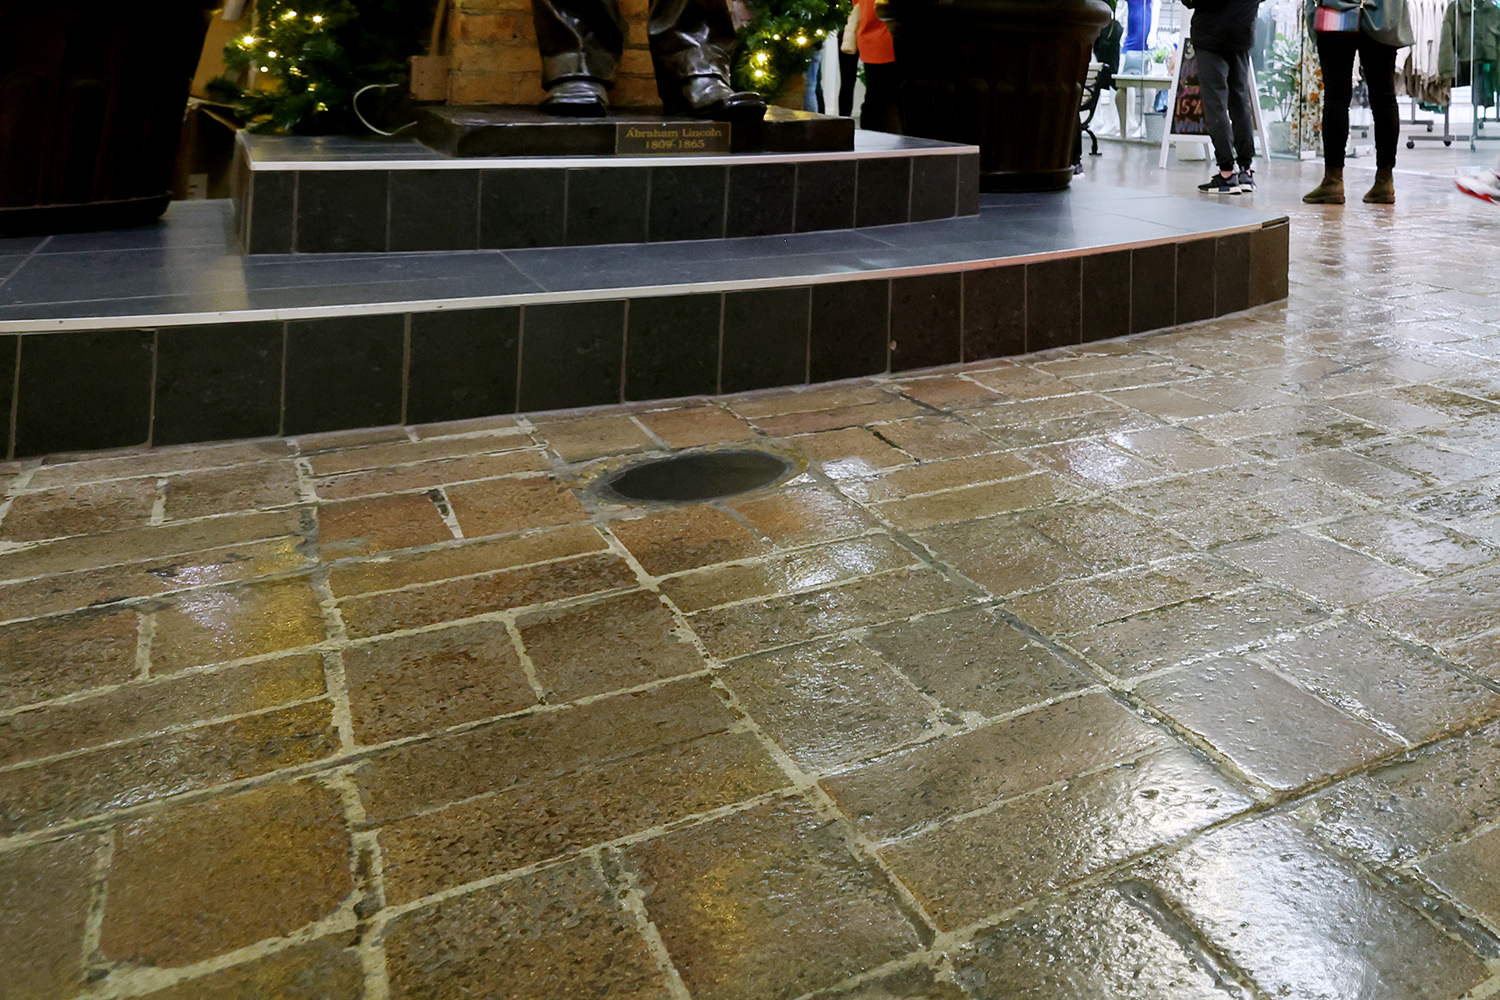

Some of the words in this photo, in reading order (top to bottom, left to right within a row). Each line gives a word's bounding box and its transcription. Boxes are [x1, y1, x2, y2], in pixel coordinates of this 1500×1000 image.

[625, 127, 678, 139] Abraham
[681, 127, 722, 138] Lincoln
[645, 139, 705, 150] 1809-1865
